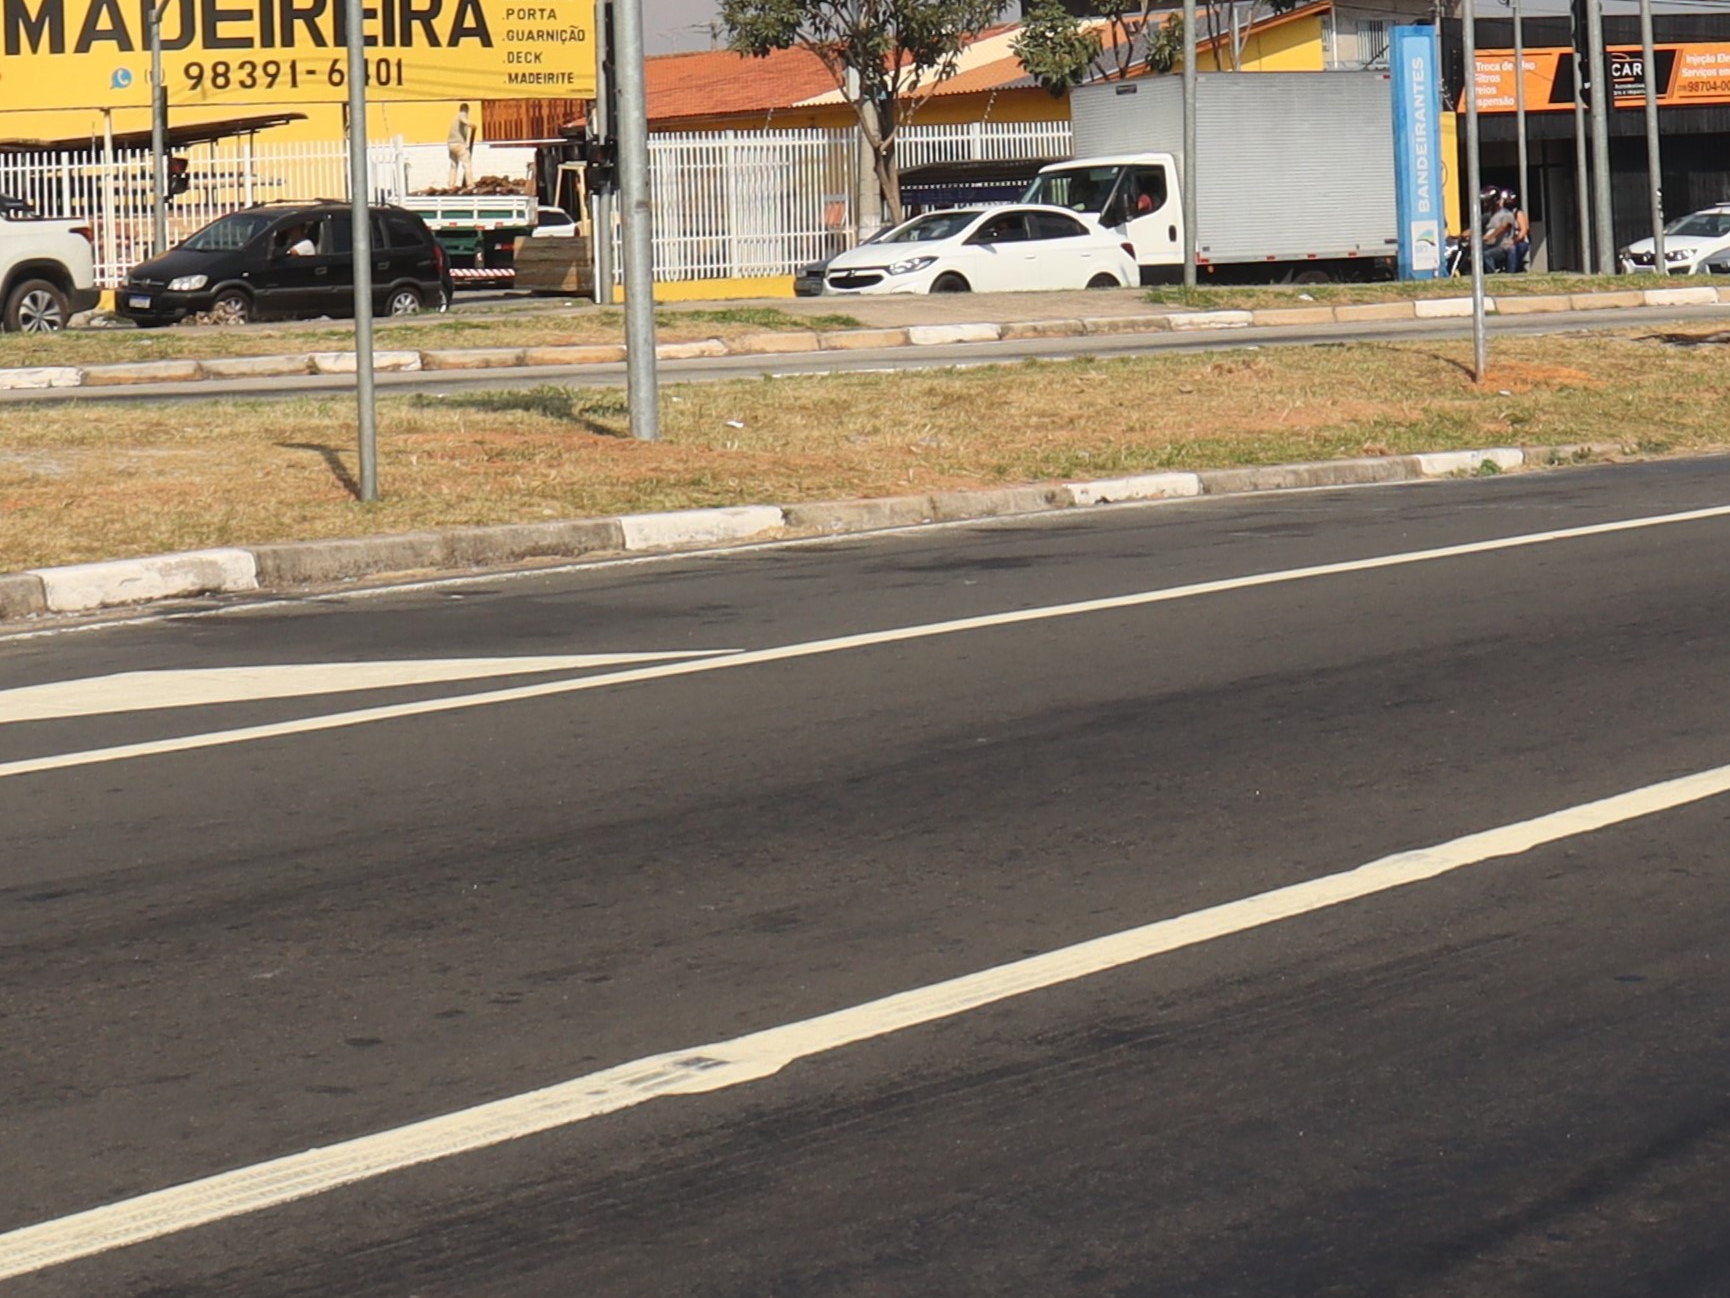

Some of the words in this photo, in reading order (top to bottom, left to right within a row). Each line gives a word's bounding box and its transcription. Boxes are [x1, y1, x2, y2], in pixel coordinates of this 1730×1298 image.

[1521, 59, 1536, 70] leo
[1611, 62, 1642, 77] CAR
[1681, 67, 1717, 78] Serviços
[1718, 68, 1730, 76] em
[1475, 84, 1497, 95] reios
[1412, 56, 1430, 214] BANDEIRANTES
